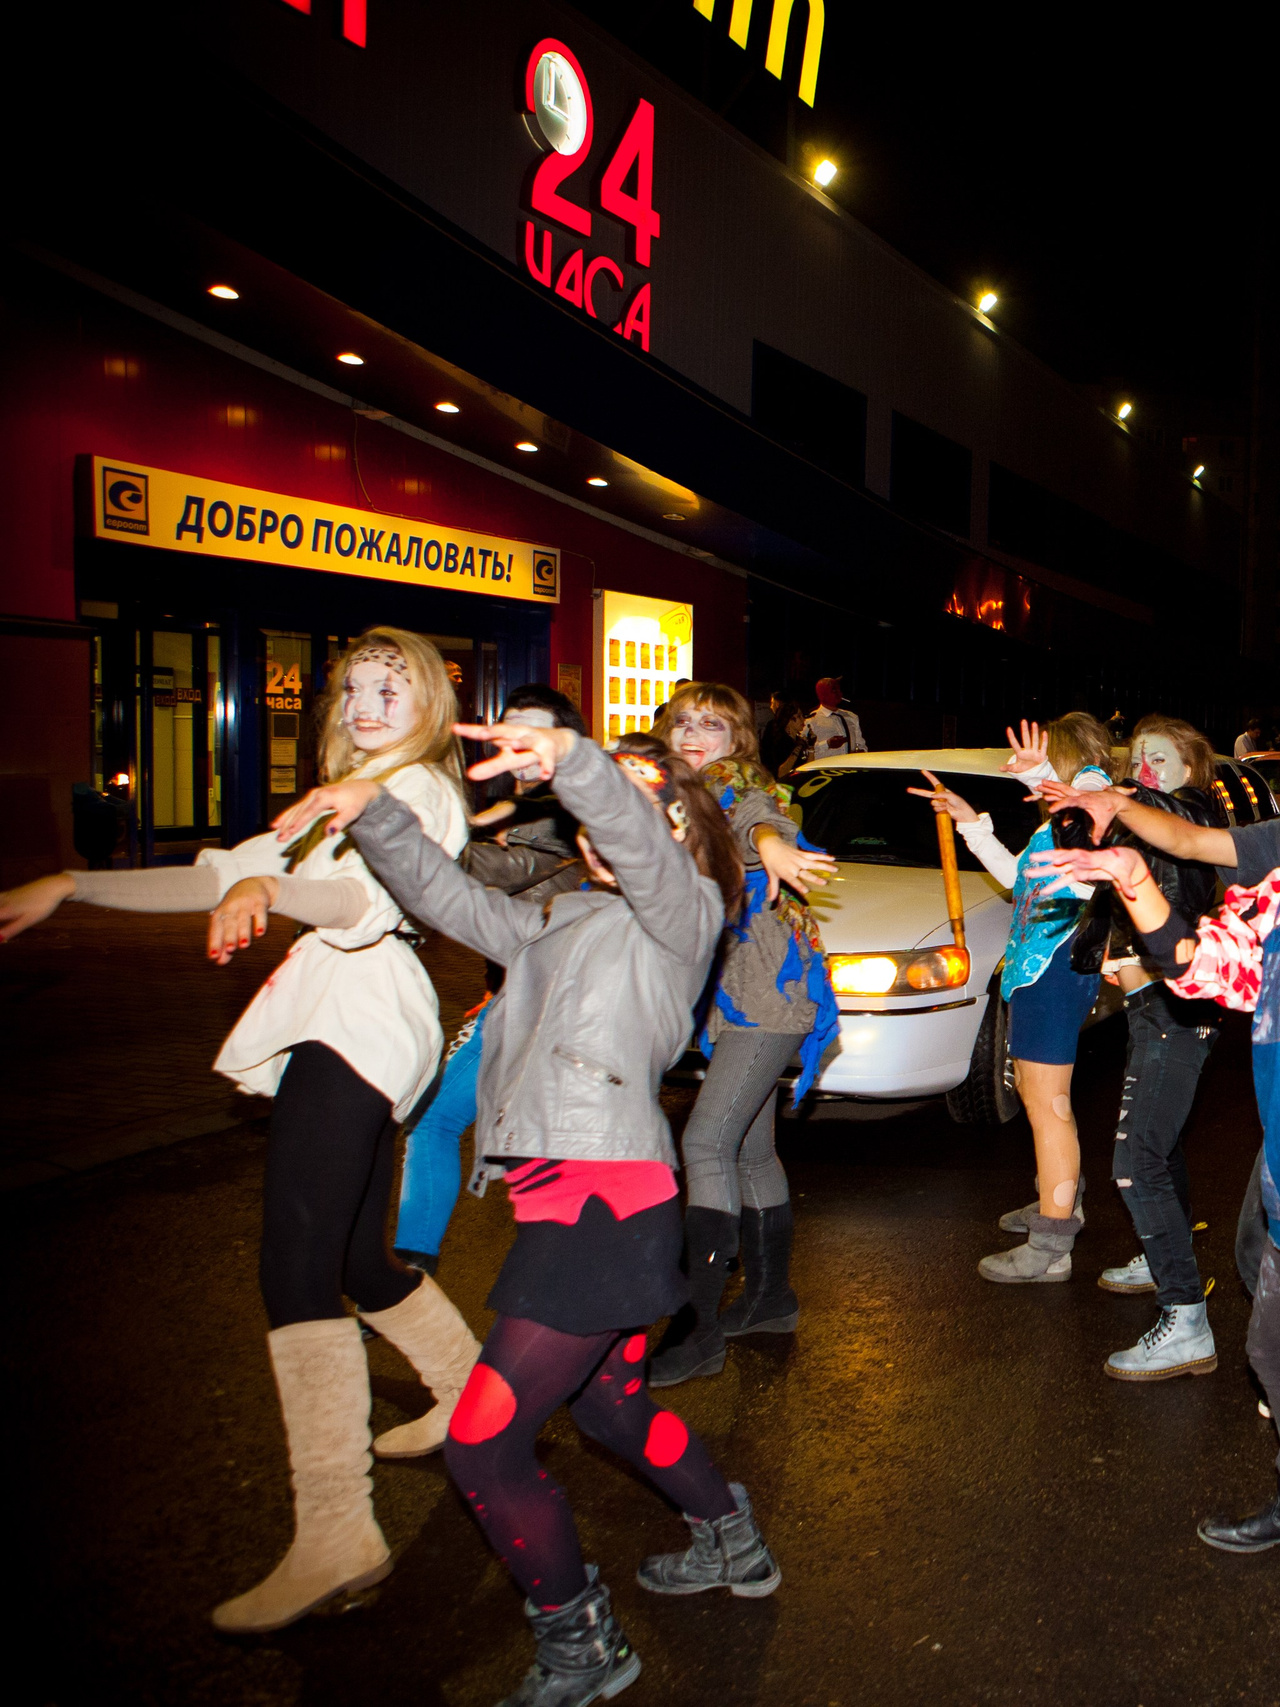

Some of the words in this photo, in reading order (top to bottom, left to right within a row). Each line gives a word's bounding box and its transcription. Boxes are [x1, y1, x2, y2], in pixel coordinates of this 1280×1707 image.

[526, 38, 659, 267] 24
[175, 495, 304, 549] ДОБРО
[311, 519, 514, 583] ПОЖАЛОВАТЬ!
[266, 661, 302, 695] 24
[266, 697, 302, 710] часа
